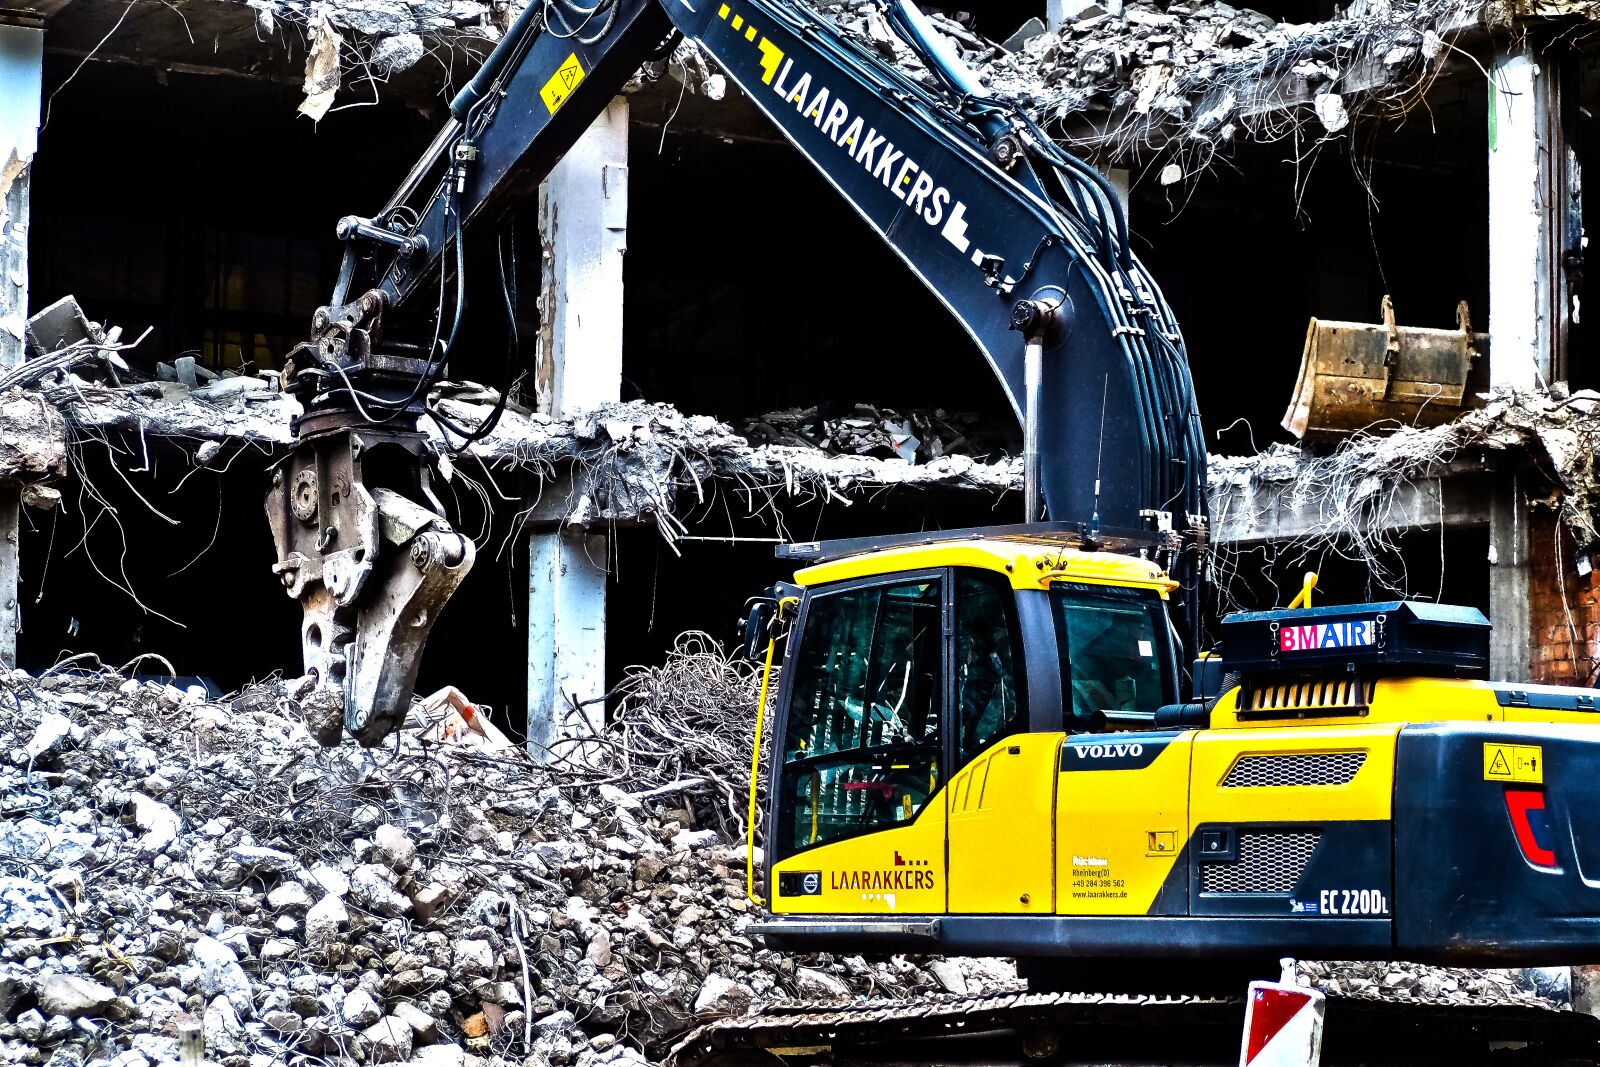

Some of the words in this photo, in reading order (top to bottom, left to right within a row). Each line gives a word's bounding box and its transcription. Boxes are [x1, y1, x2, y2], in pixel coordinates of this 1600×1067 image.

[773, 58, 950, 226] LAARAKKERS
[1280, 621, 1366, 651] BMAIR
[1074, 744, 1143, 759] VOLVO
[831, 870, 934, 890] LAARAKKERS
[1072, 880, 1085, 888] +49
[1086, 880, 1098, 888] 284
[1320, 889, 1339, 915] EC
